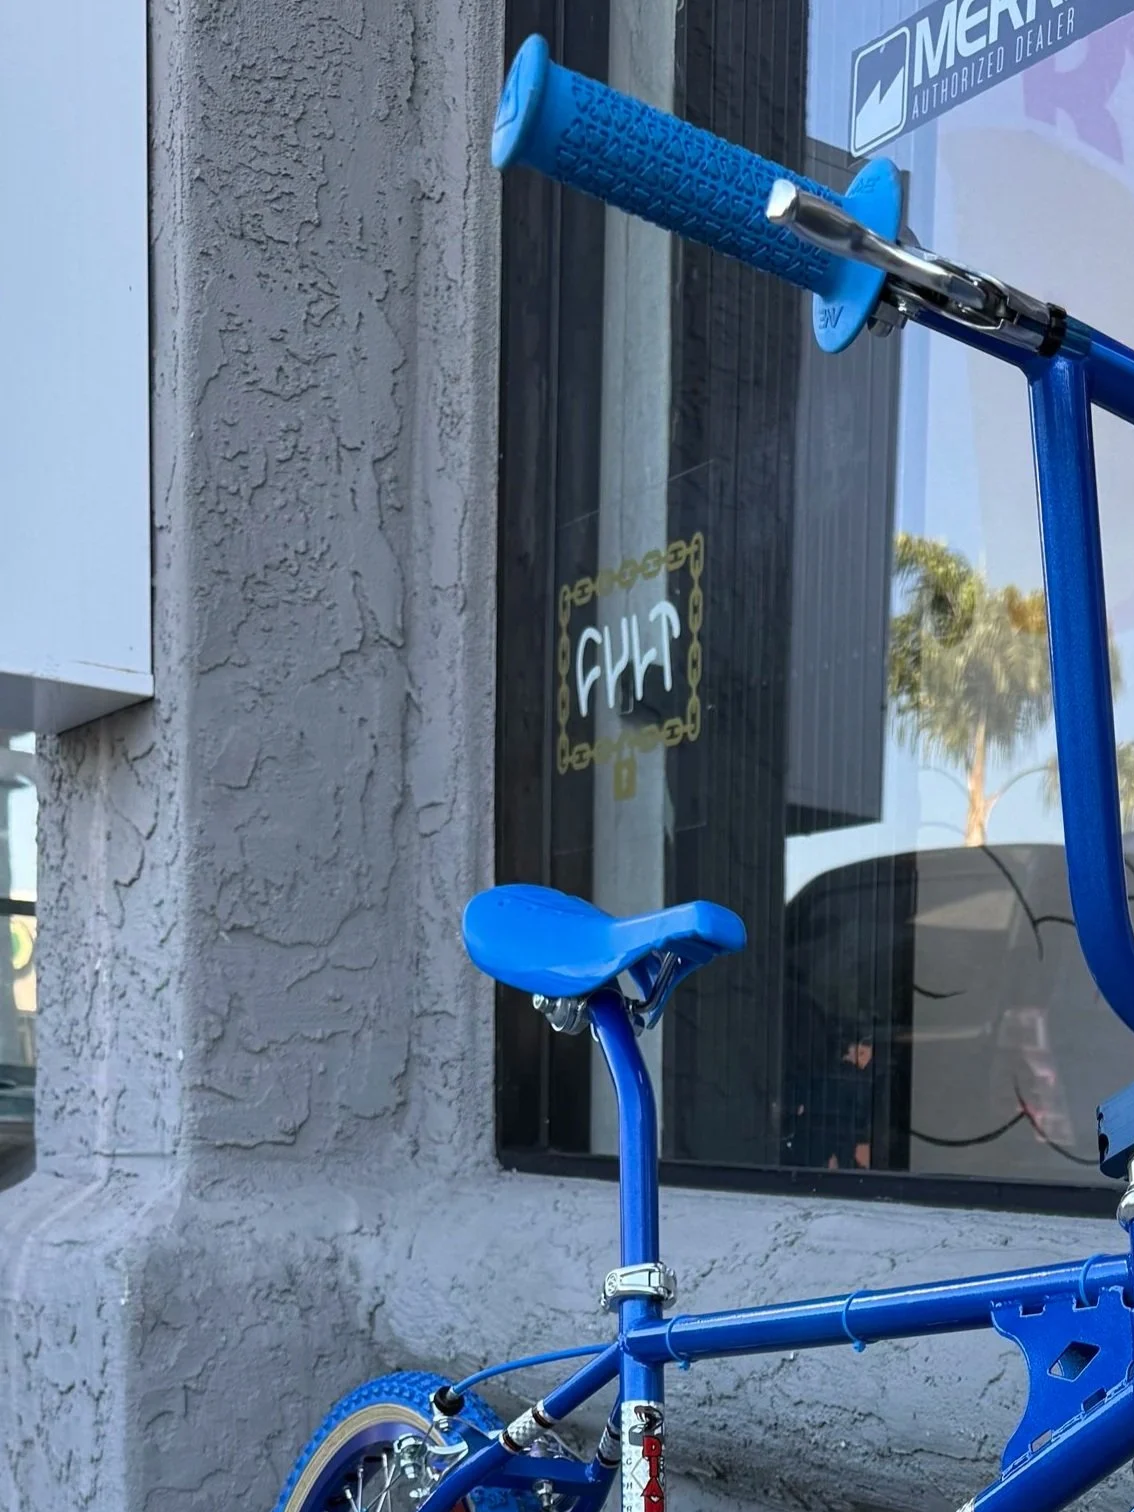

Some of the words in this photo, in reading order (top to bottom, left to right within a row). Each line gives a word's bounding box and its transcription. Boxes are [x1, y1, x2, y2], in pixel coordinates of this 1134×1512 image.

[911, 46, 1004, 120] AUTHORIZED
[1015, 7, 1075, 63] DEALER
[576, 600, 681, 717] CULT
